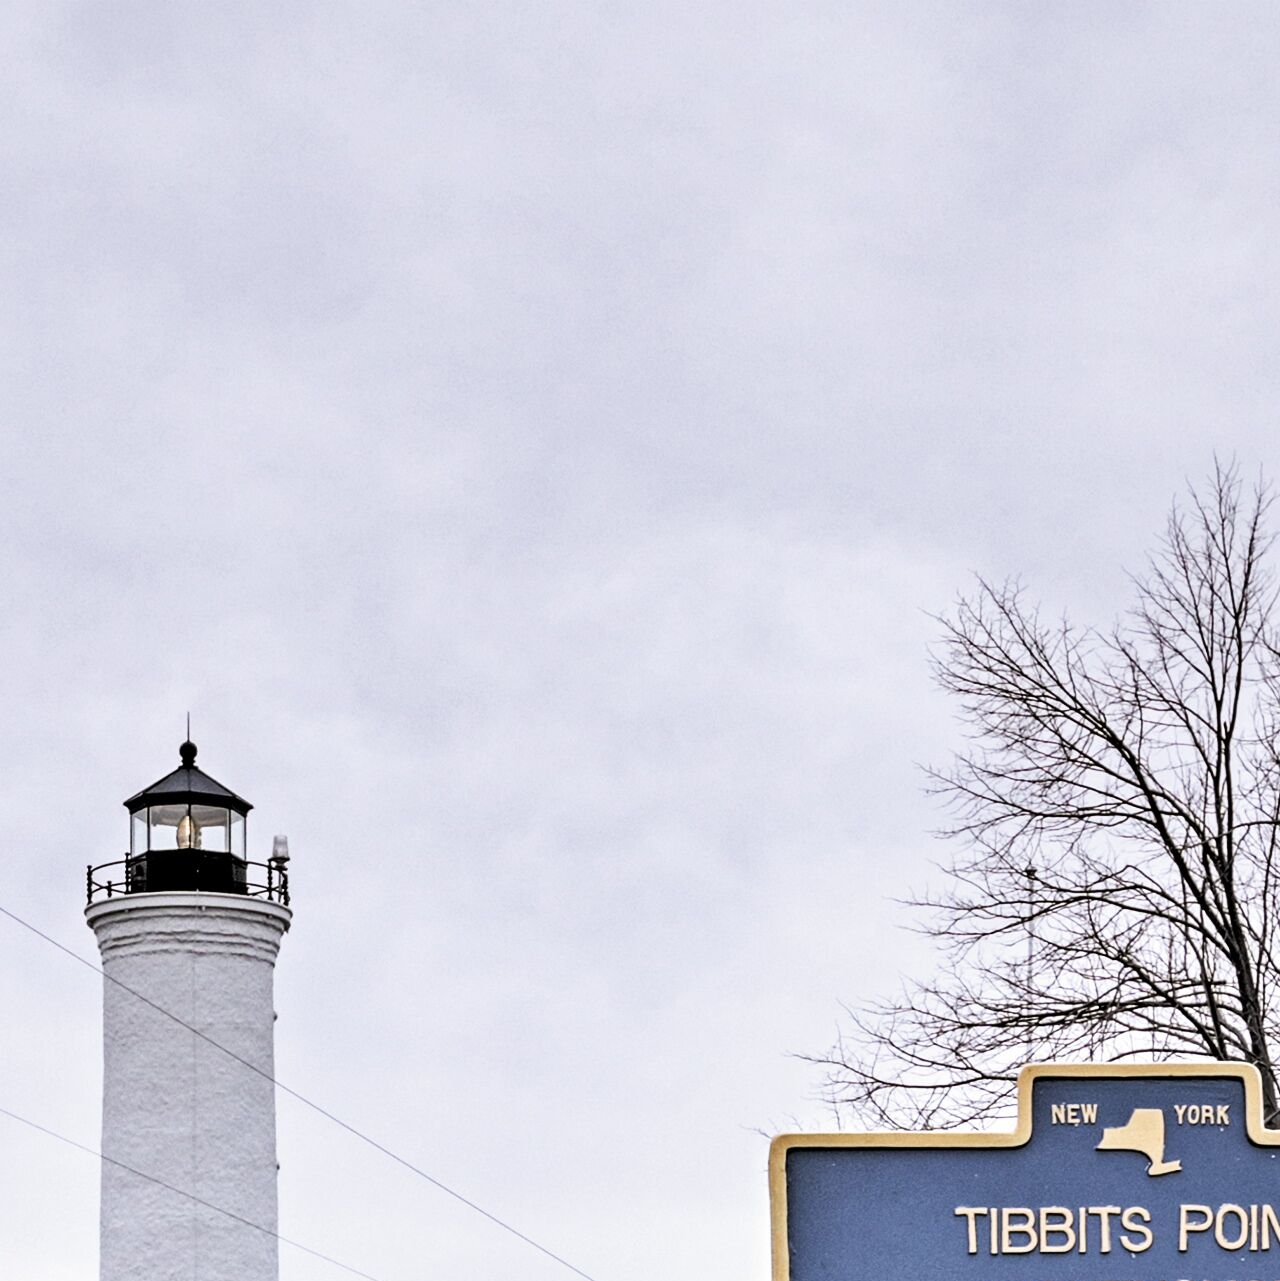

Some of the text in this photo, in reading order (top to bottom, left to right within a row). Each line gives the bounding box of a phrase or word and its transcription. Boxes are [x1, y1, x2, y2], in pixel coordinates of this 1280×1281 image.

[1051, 1104, 1230, 1125] NEW YORK
[955, 1204, 1154, 1254] TIBBITS
